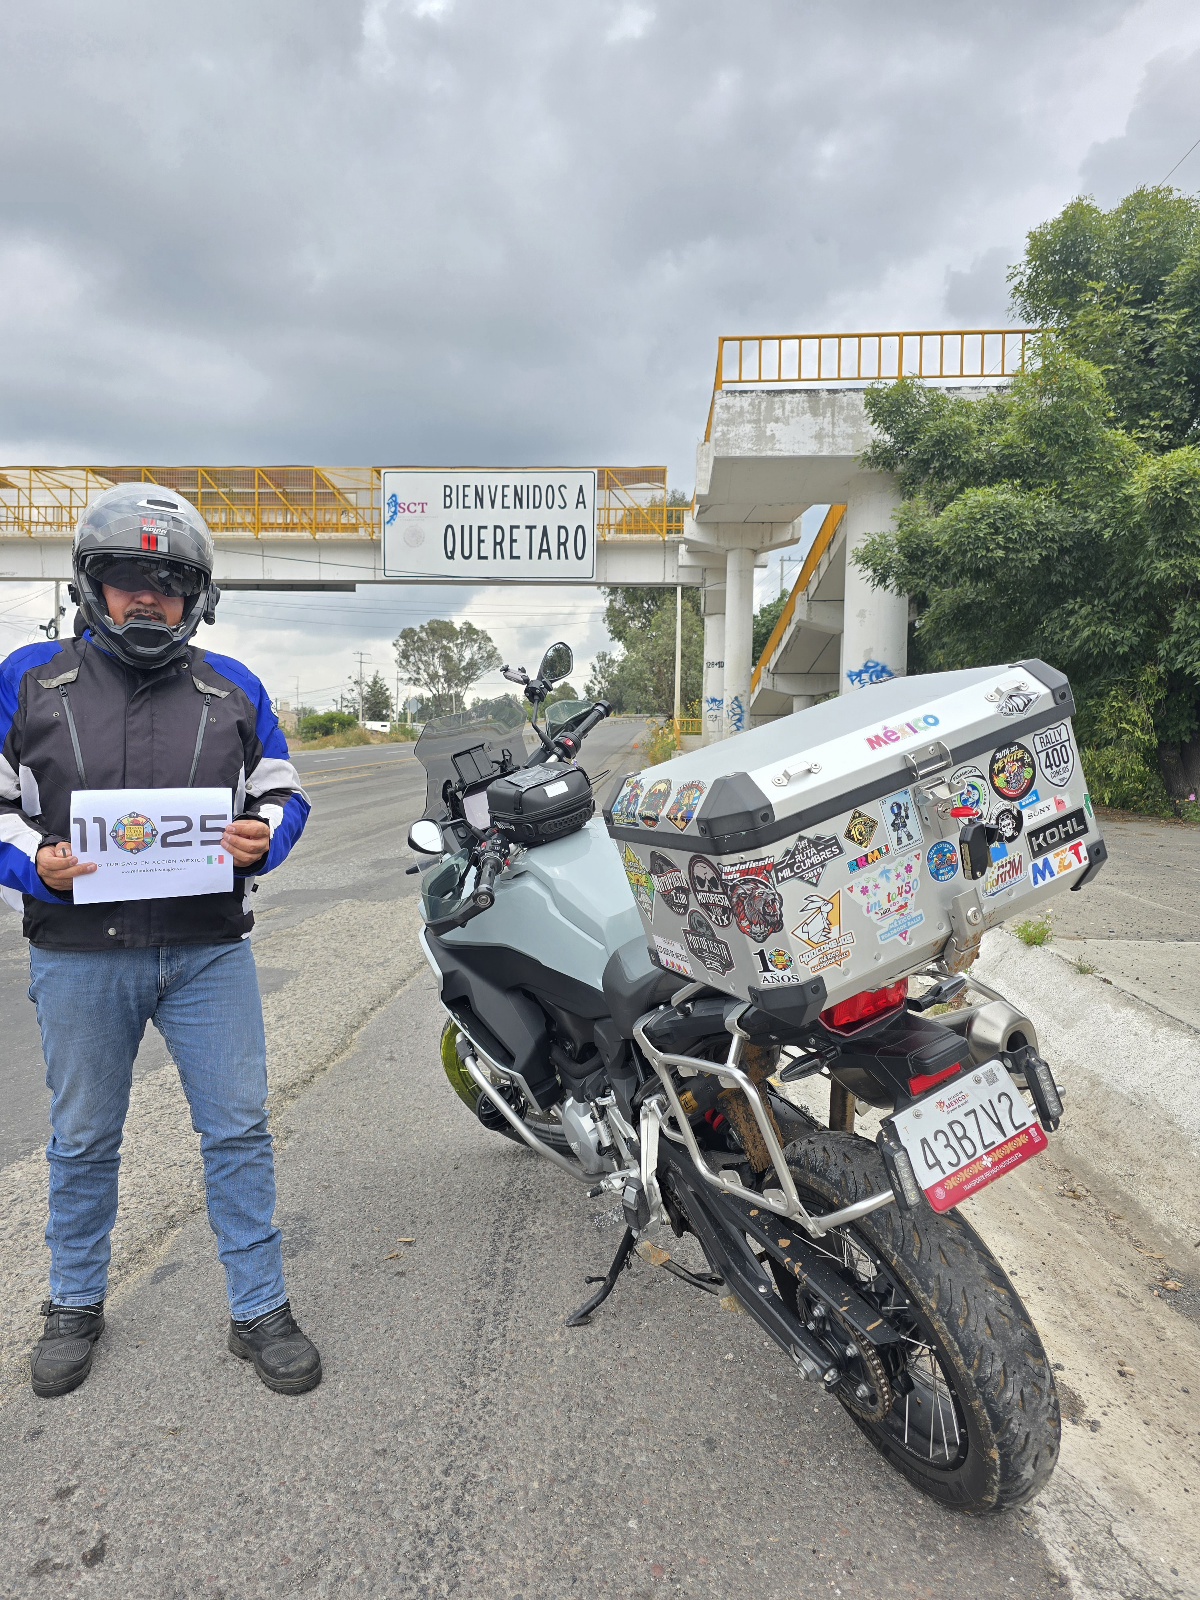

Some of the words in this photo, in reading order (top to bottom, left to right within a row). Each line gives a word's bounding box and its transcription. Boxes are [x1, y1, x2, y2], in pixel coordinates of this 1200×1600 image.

[443, 484, 567, 509] BIENVENIDOS
[575, 484, 587, 509] A
[398, 502, 428, 514] SCT
[443, 524, 587, 560] QUERETARO
[1039, 728, 1063, 749] RALLY
[992, 749, 1025, 774] PEYOTE
[1044, 744, 1070, 771] 400
[1050, 765, 1070, 780] CONEJOS
[1027, 804, 1051, 821] SONY
[1031, 817, 1084, 852] KOHL
[778, 867, 795, 881] MIL
[793, 845, 840, 873] CUMBRES
[795, 847, 818, 863] RUTA
[802, 867, 823, 881] 2019
[695, 891, 732, 909] MOTOFIESTA
[686, 933, 731, 961] MOTOFIESTA
[762, 973, 800, 984] AÑOS
[920, 1092, 1027, 1175] 43BZV2
[961, 1173, 986, 1192] TRANSPORTE
